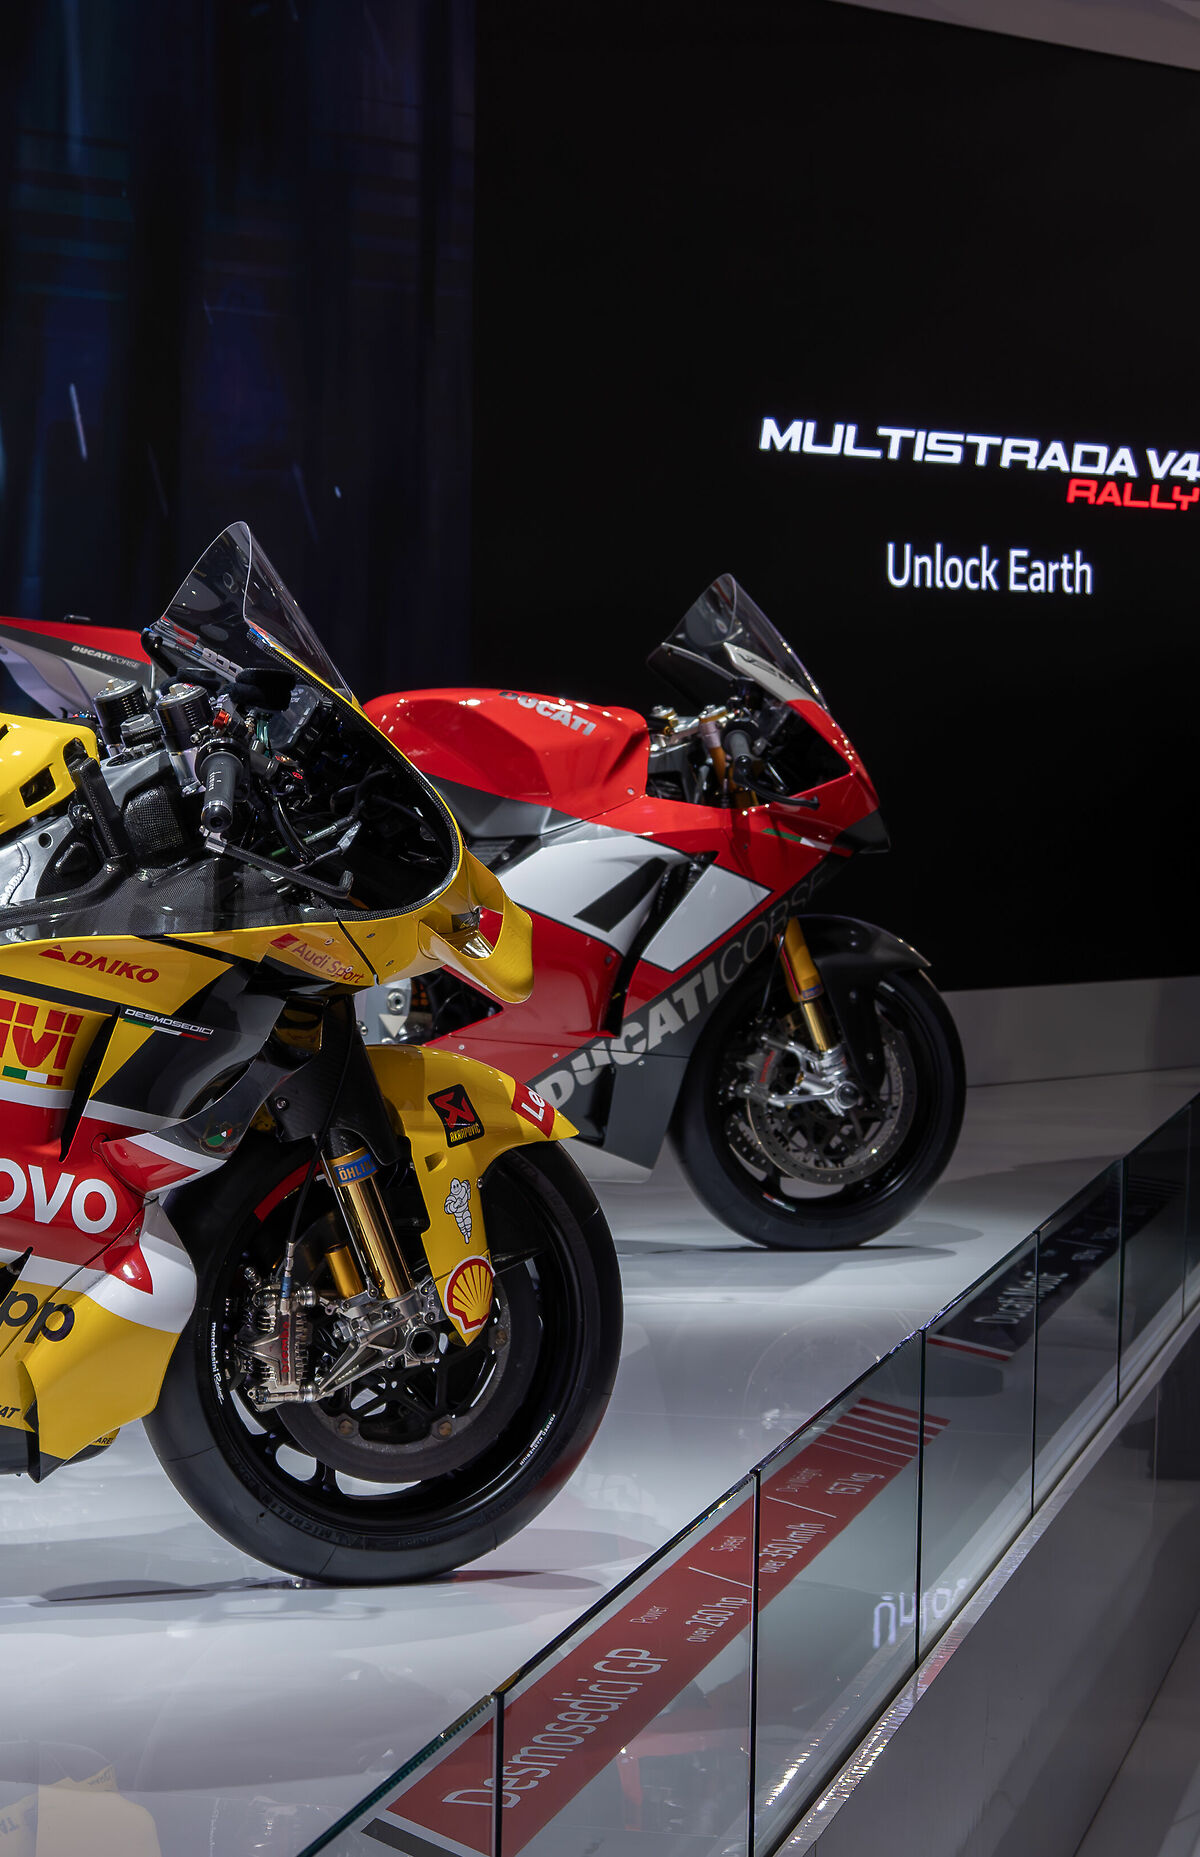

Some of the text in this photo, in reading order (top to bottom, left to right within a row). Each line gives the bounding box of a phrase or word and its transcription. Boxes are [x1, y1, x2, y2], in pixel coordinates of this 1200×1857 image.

[758, 416, 1200, 482] MULTISTRADA V4
[1065, 477, 1200, 511] RALLY
[886, 541, 1093, 594] Unlock Earth
[497, 691, 597, 737] DUCATI
[291, 941, 366, 985] Audi Sport
[124, 1007, 215, 1036] DESMOSEDICI
[279, 1321, 290, 1374] brembo
[758, 1543, 804, 1560] 350
[770, 1523, 827, 1544] km/h
[628, 1603, 670, 1625] Power
[684, 1596, 751, 1643] over 260 hp
[441, 1646, 669, 1809] Desmosedici GP
